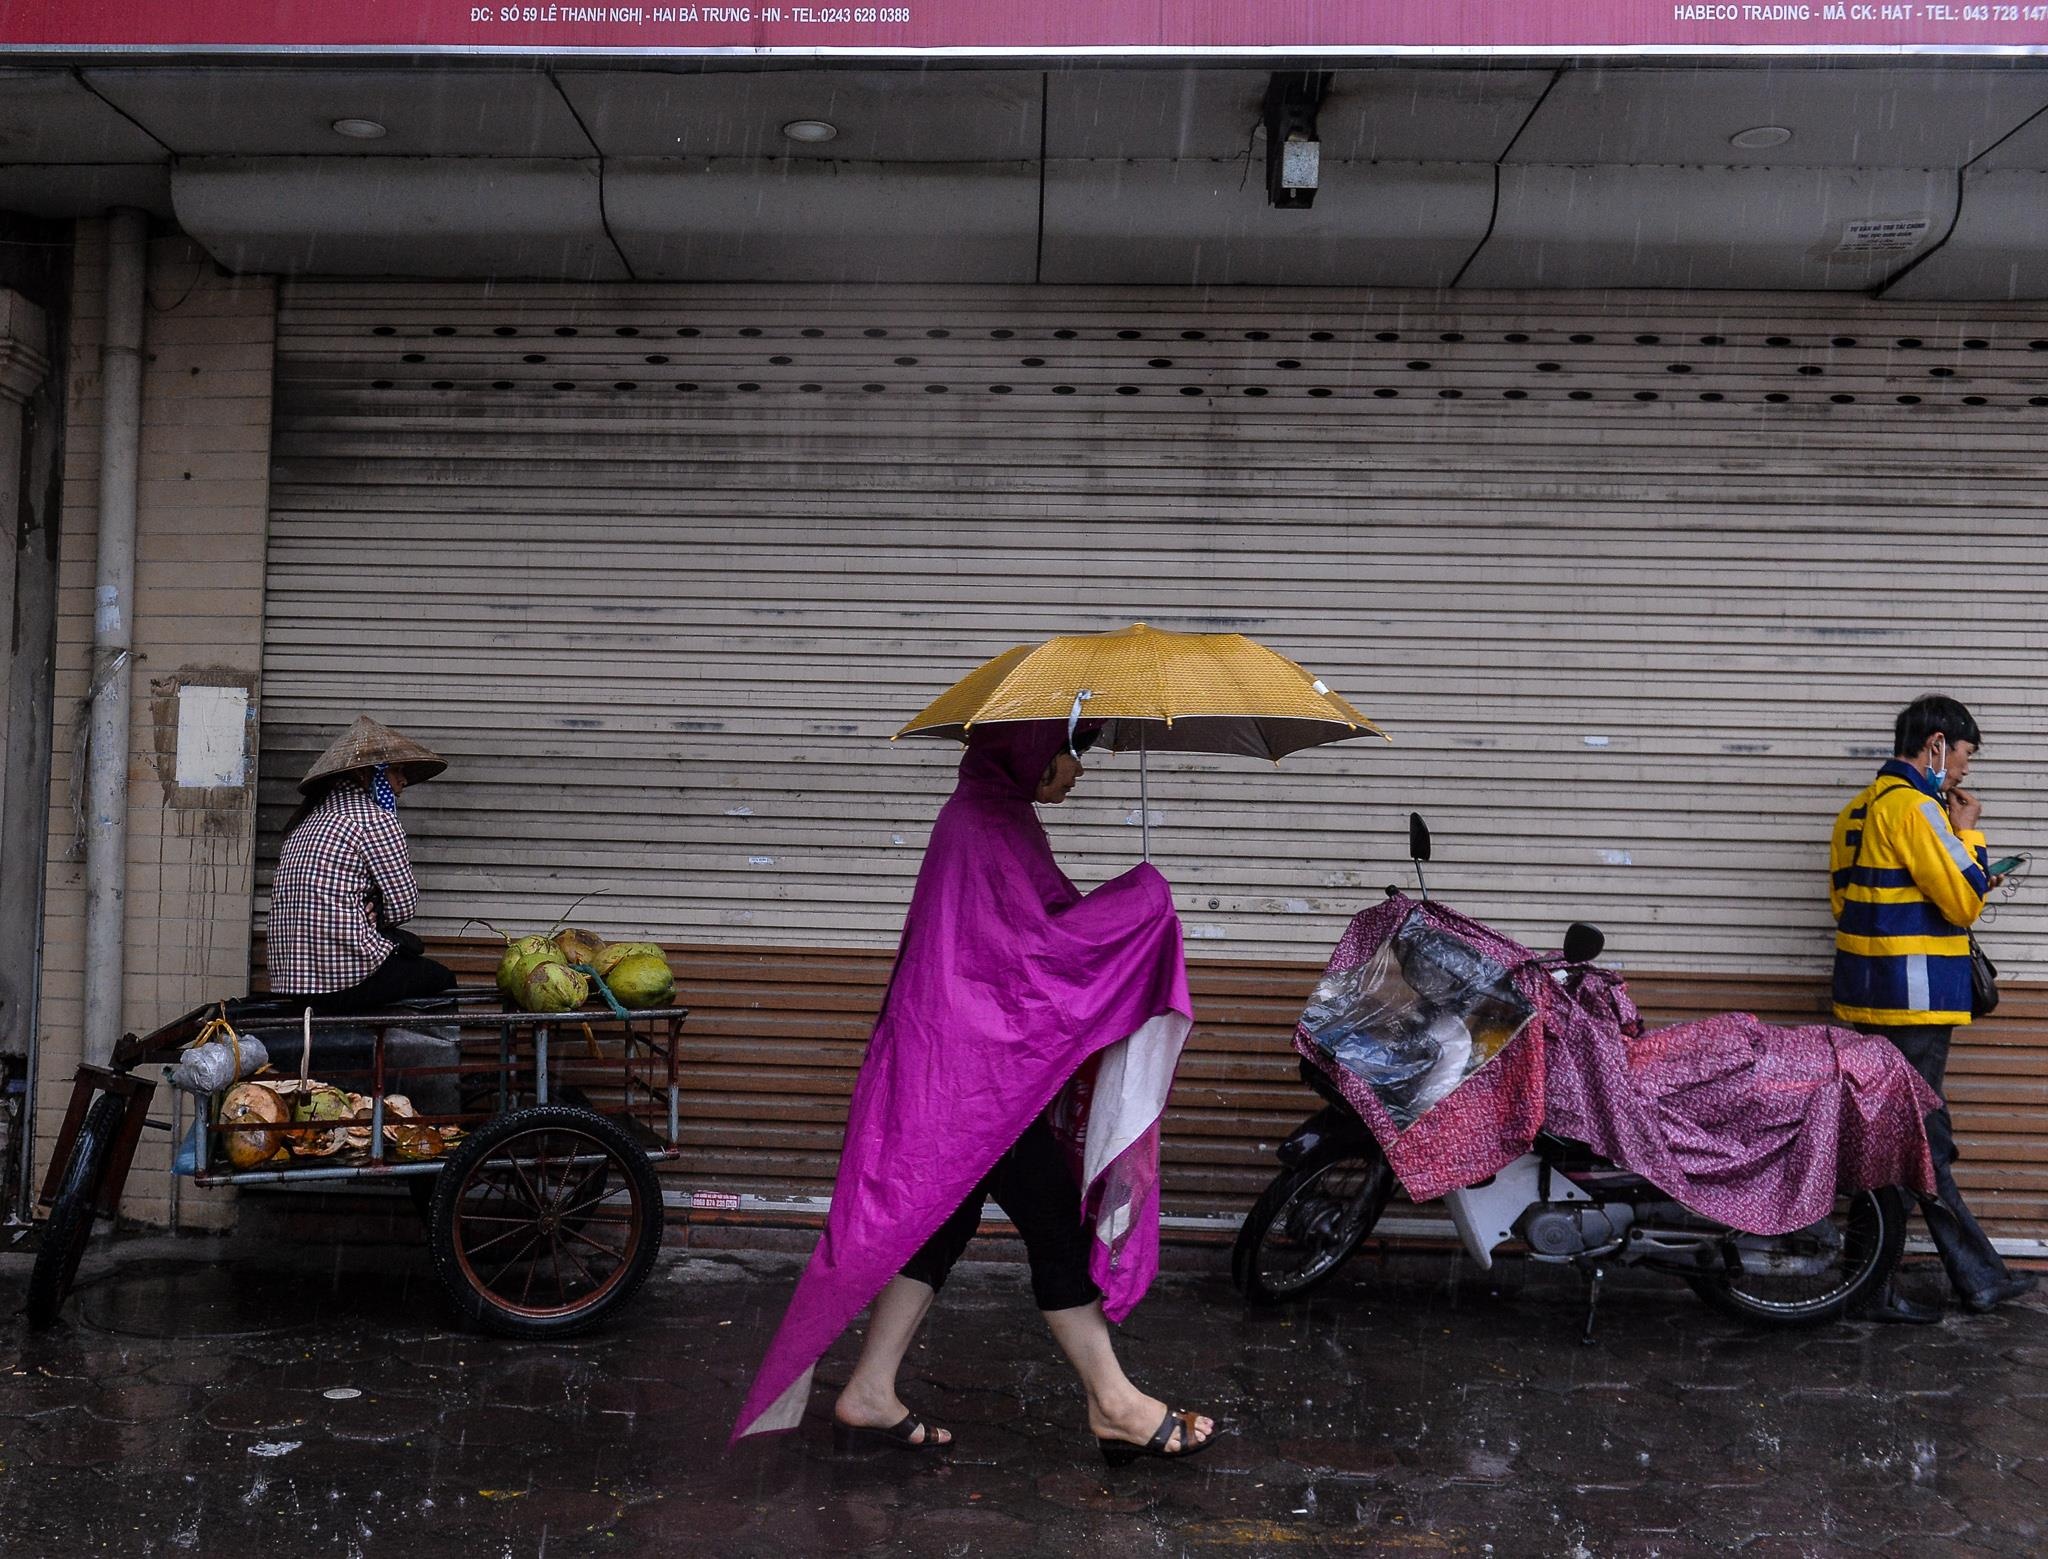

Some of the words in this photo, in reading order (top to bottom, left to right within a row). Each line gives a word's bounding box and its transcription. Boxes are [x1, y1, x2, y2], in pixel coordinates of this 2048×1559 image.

[470, 7, 493, 22] ĐC:
[522, 7, 537, 22] 59
[540, 3, 557, 22] LÊ
[560, 7, 606, 22] THANH
[609, 7, 642, 25] NGHỊ
[653, 7, 676, 22] HAI
[679, 3, 698, 22] BÀ
[701, 6, 749, 22] TRƯNG
[761, 7, 780, 22] HN
[853, 7, 876, 22] 628
[879, 7, 909, 22] 0388
[1674, 4, 1738, 20] HABECO
[1741, 4, 1809, 20] TRADING
[1822, 1, 1846, 20] MÃ
[1850, 4, 1876, 20] CK:
[1881, 4, 1912, 20] HAT
[1924, 4, 1959, 20] TEL:
[1962, 5, 1989, 21] 043
[1992, 5, 2019, 21] 728
[2022, 5, 2048, 21] 147
